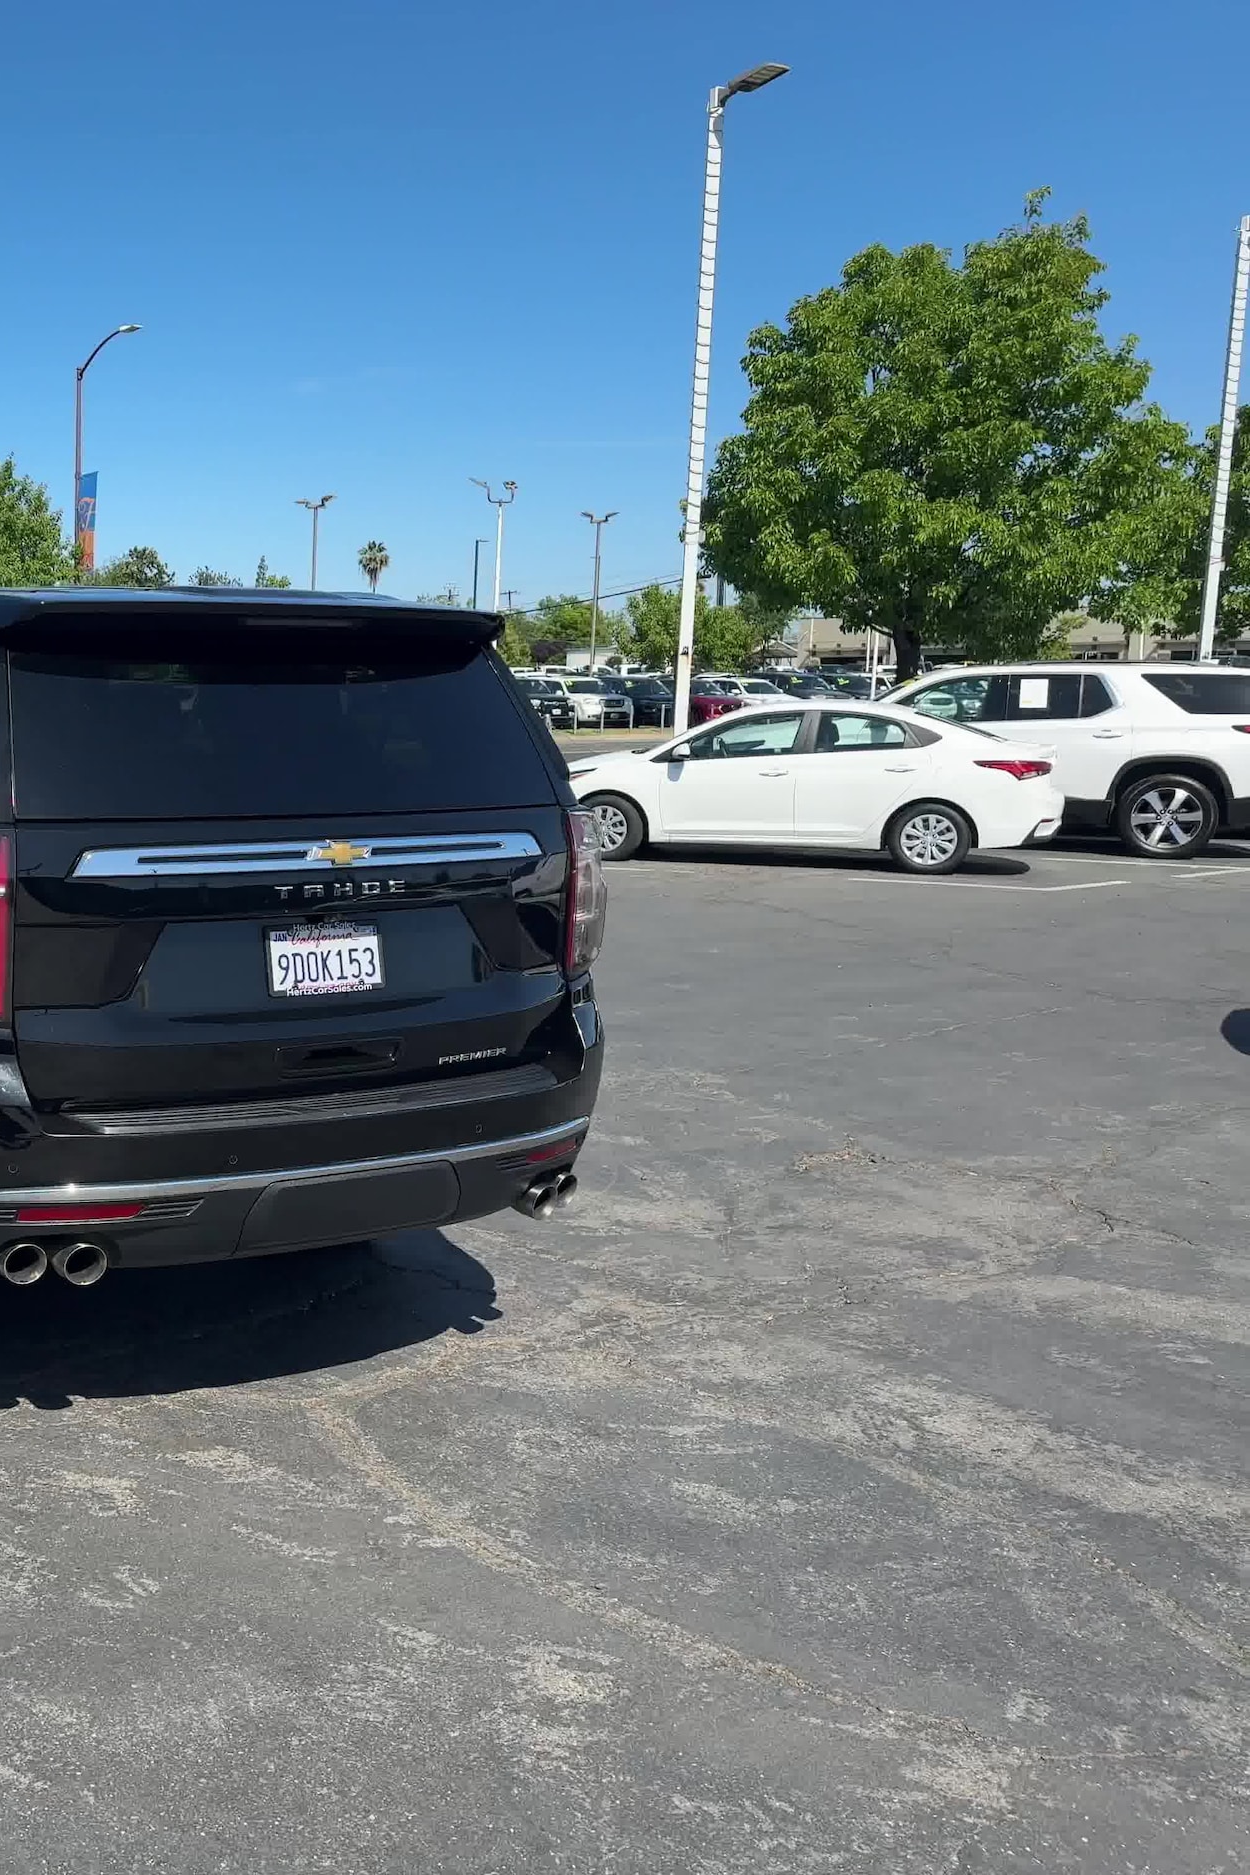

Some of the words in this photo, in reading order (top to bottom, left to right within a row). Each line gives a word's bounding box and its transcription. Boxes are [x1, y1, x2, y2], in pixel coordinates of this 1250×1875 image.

[274, 880, 405, 899] TAHOE
[293, 922, 316, 932] Hertz
[318, 922, 332, 931] Car
[334, 921, 356, 930] Sales
[273, 932, 288, 942] JAN
[290, 929, 356, 948] California
[286, 983, 373, 997] HertzCarSales.com
[438, 1047, 507, 1065] PREMIER
